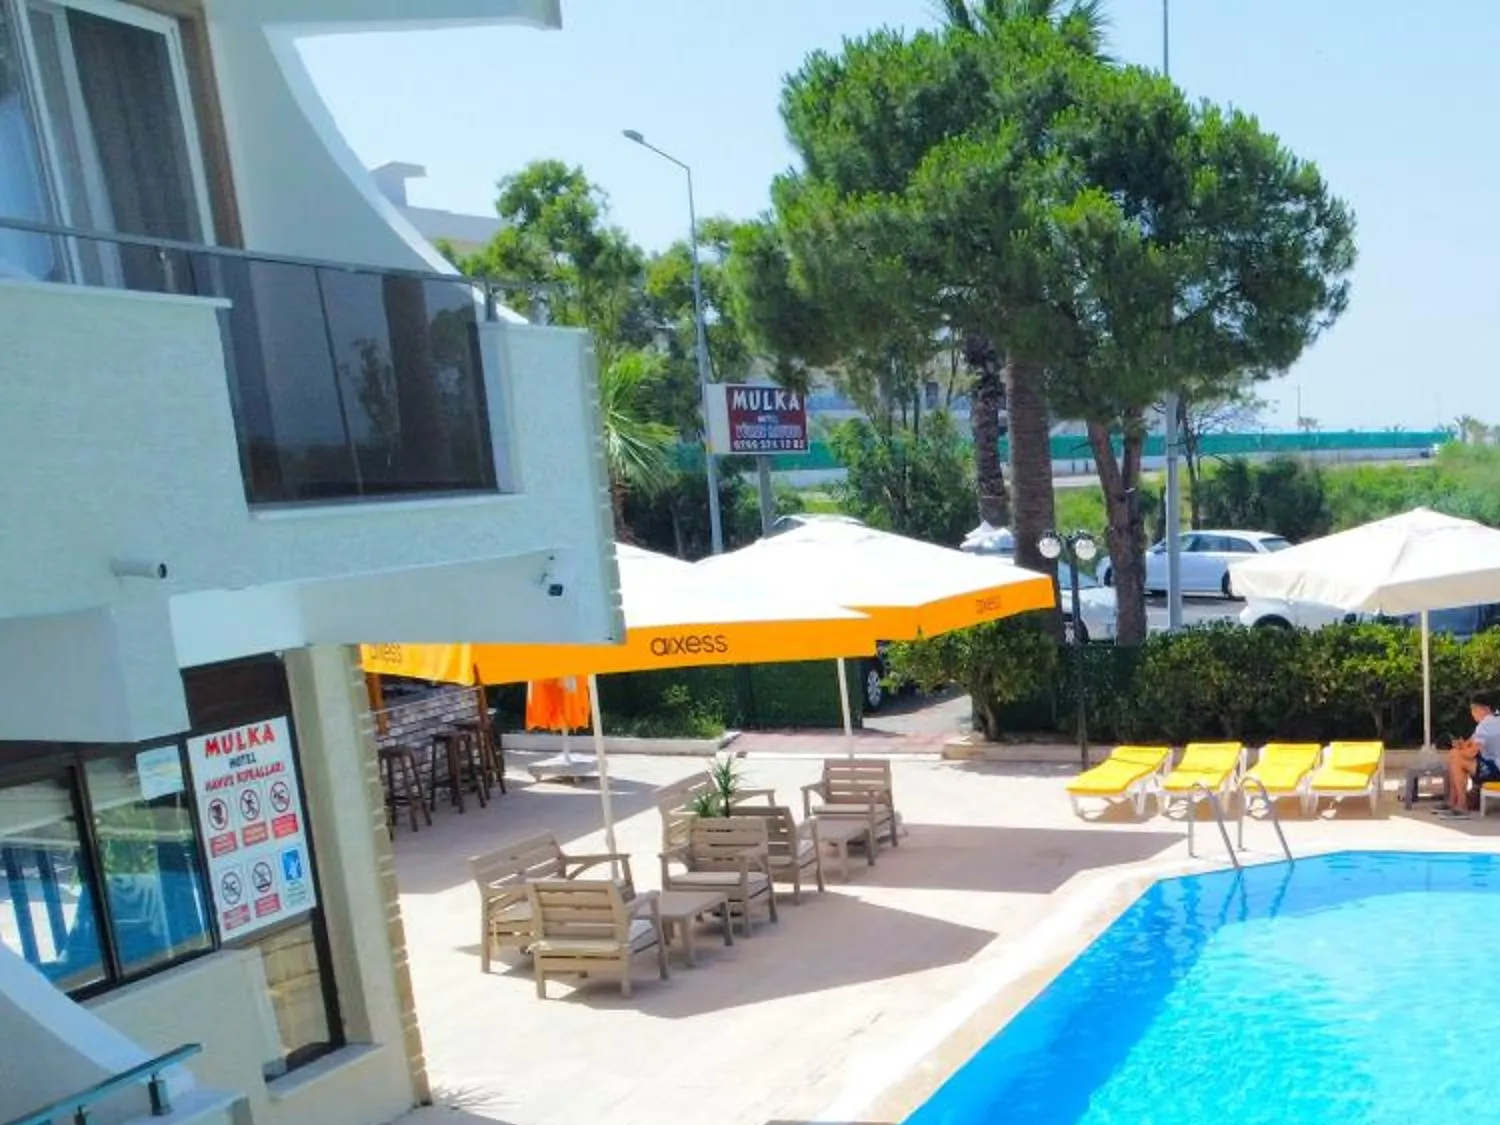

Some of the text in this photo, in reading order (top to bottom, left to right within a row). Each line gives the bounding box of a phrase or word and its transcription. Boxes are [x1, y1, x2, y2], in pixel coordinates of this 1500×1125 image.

[732, 389, 800, 411] MULKA
[650, 635, 729, 656] axess
[205, 723, 275, 759] MULKA
